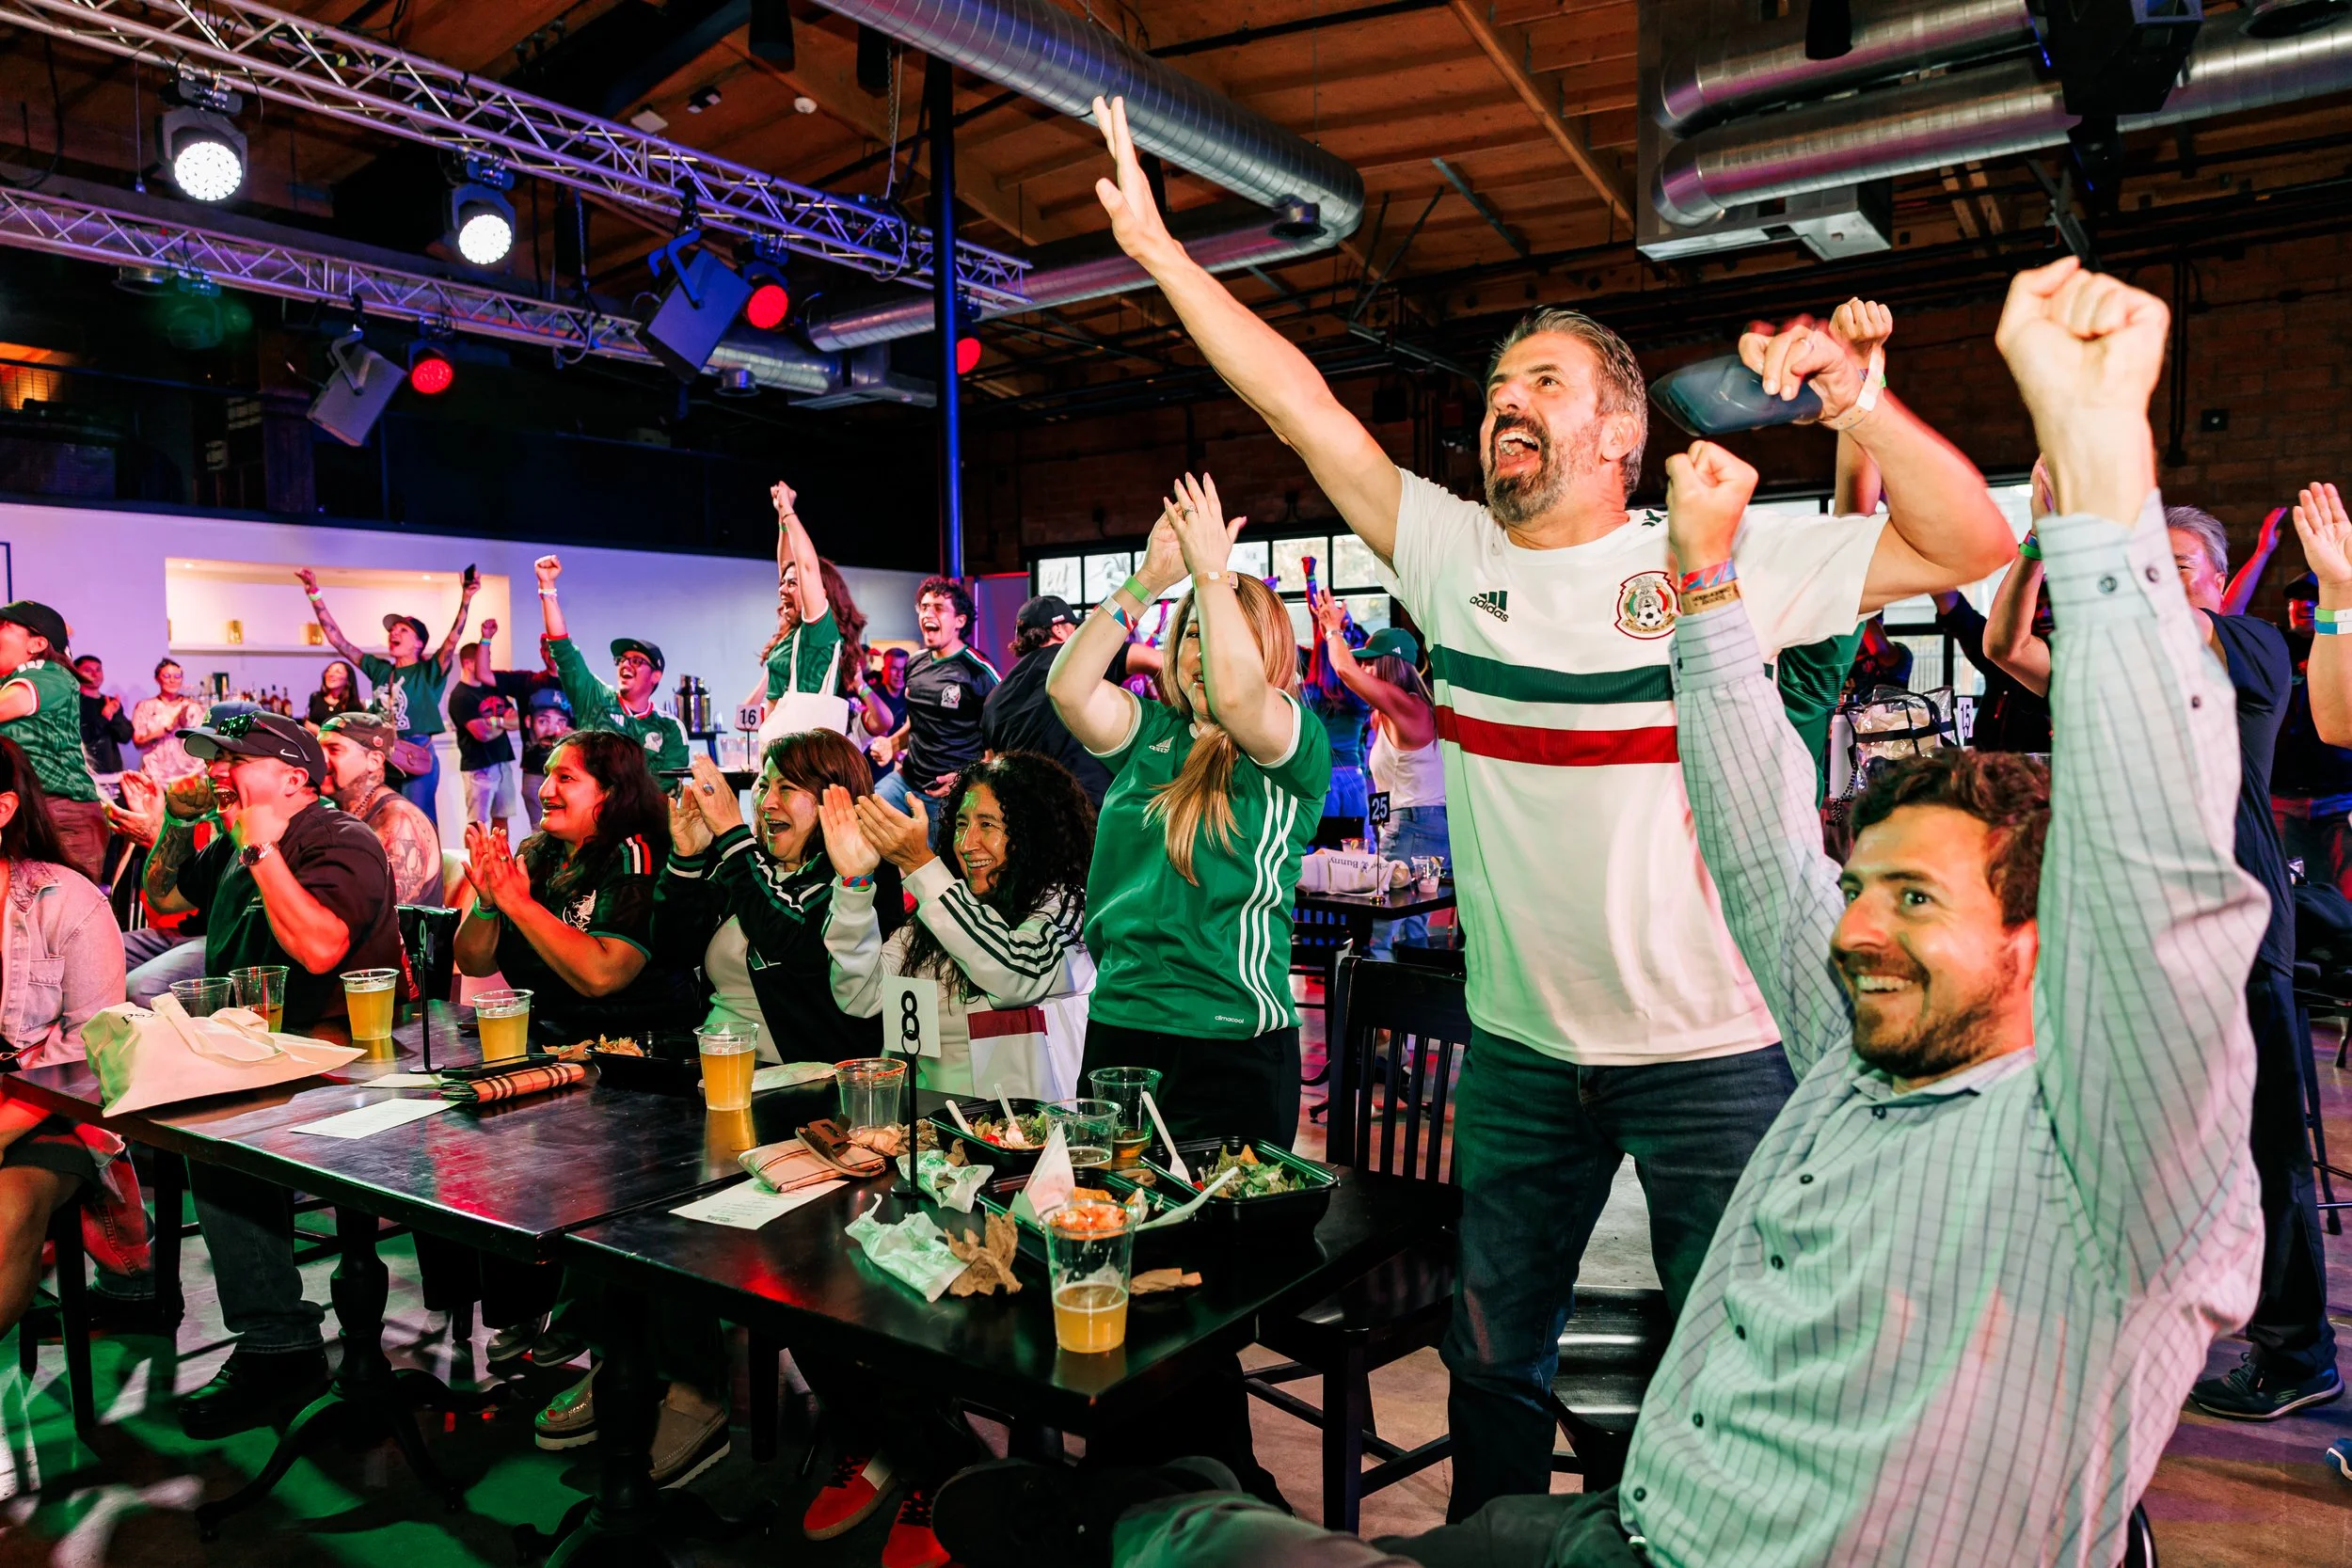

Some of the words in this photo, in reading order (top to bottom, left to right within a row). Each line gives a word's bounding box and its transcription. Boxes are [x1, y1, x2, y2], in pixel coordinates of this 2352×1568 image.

[1470, 595, 1509, 623] adidas
[739, 708, 756, 725] 16
[1961, 704, 1971, 729] 15
[1372, 796, 1388, 820] 25
[1329, 856, 1359, 869] Bunny
[900, 990, 920, 1041] 8
[1215, 1015, 1244, 1024] climacool
